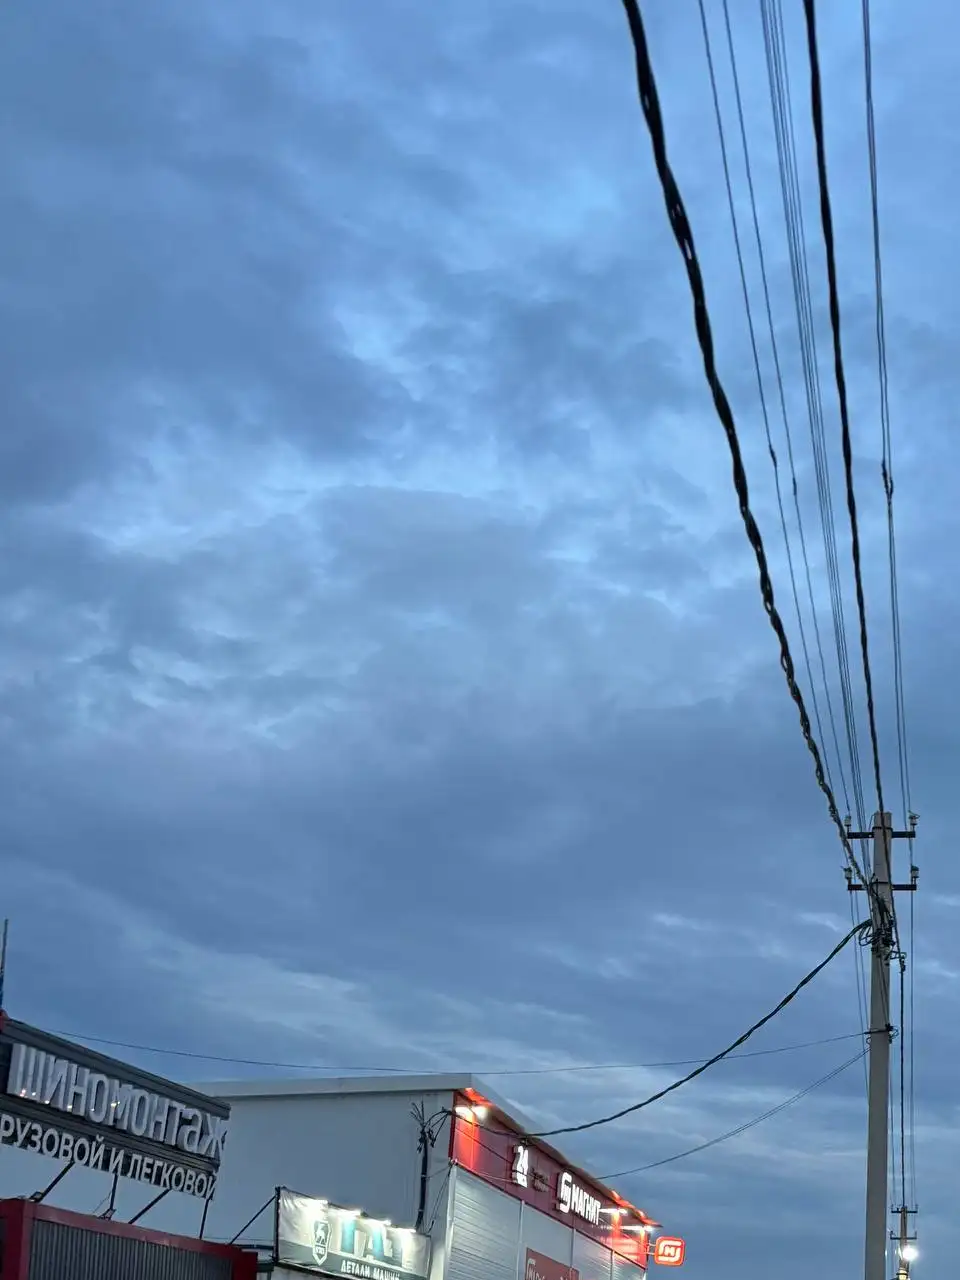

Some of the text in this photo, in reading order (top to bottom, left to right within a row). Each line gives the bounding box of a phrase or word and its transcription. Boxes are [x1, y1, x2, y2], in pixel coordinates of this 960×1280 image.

[0, 1113, 219, 1200] РУЗОВОЙ И ЛЕГКОВОЙ
[571, 1184, 601, 1225] МАГНИТ
[340, 1259, 371, 1278] ДЕТАЛИ
